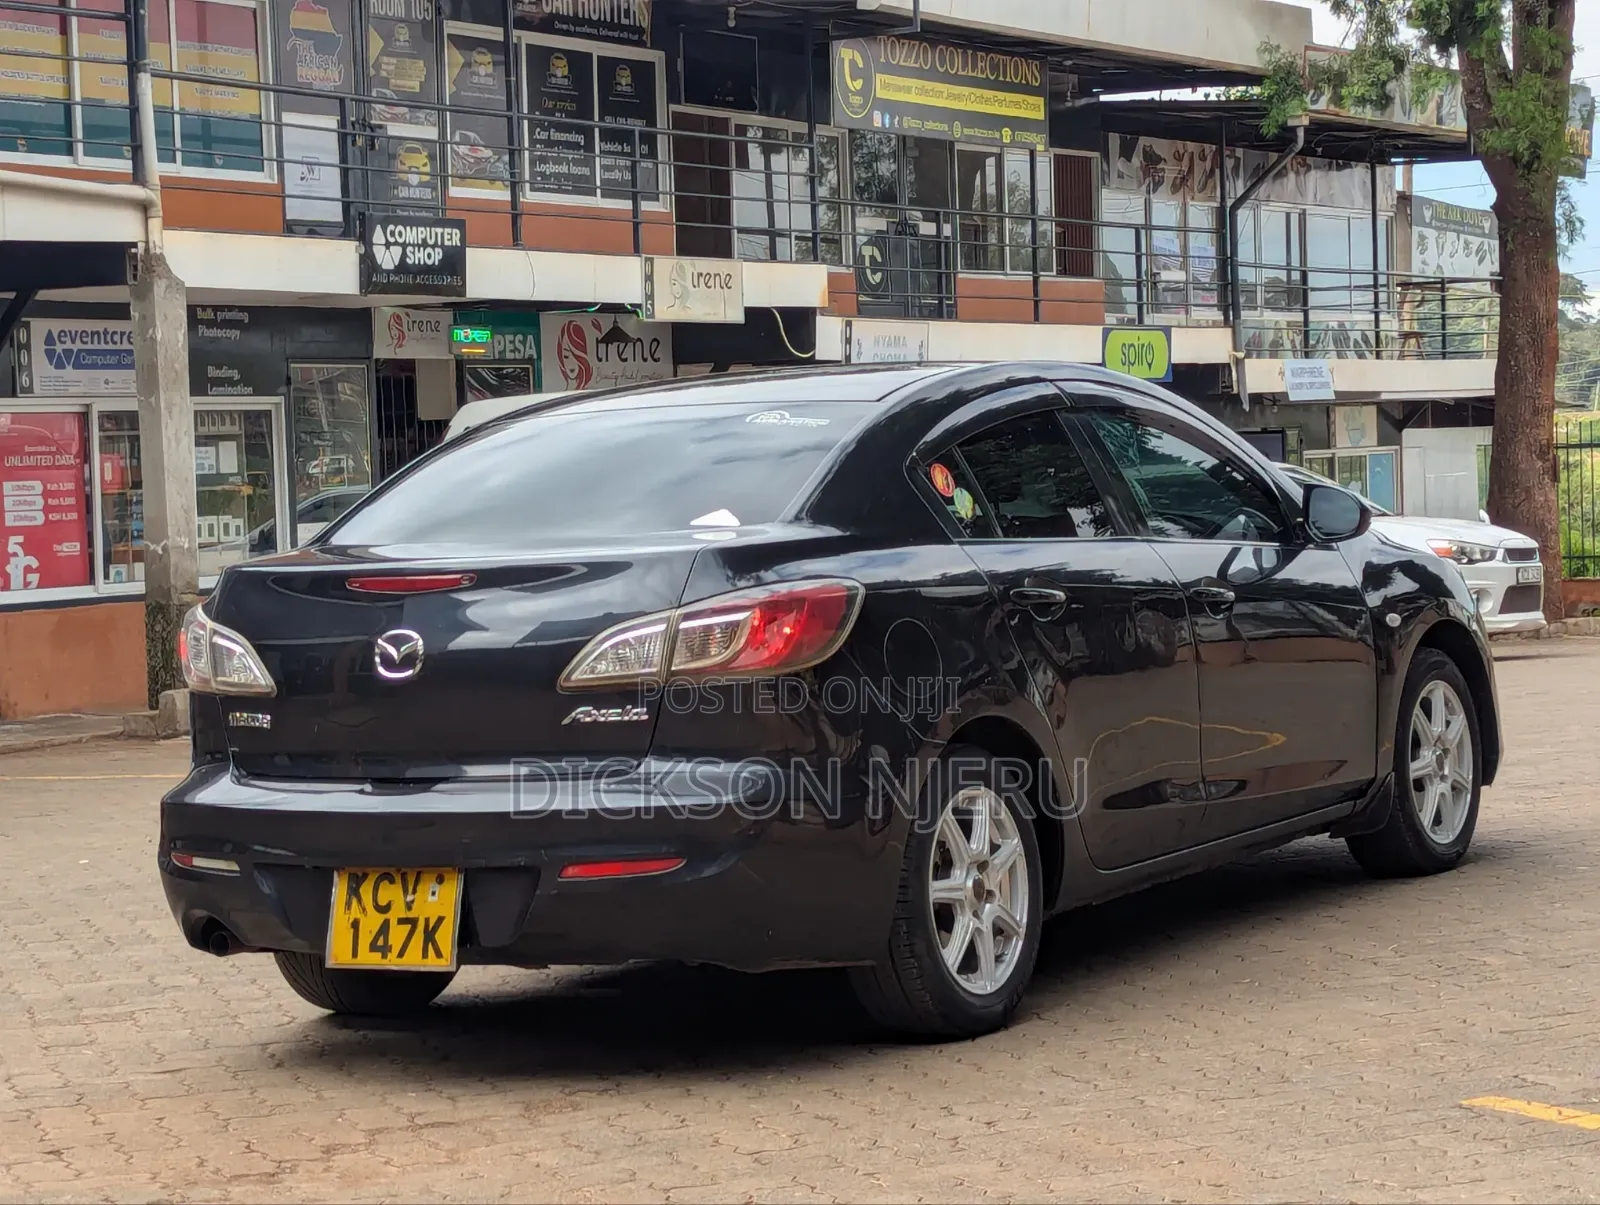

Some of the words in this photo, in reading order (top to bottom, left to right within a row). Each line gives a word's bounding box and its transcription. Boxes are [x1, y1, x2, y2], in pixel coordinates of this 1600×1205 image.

[877, 35, 932, 70] TOZZO
[935, 45, 1041, 87] COLLECTIONS
[386, 224, 461, 247] COMPUTER
[406, 246, 443, 265] SHOP
[196, 308, 216, 320] Bulk
[217, 310, 249, 324] printing
[406, 318, 441, 333] irene
[198, 325, 241, 340] Photocopy
[873, 335, 908, 349] NYAMA
[494, 334, 538, 359] PESA
[595, 336, 661, 362] irene
[1120, 336, 1155, 373] spiro
[80, 353, 119, 367] Computer
[208, 383, 254, 395] Lamination
[4, 455, 53, 467] UNLIMITED
[54, 454, 76, 467] DATA
[561, 705, 650, 725] Axela
[344, 870, 423, 917] KCV
[350, 915, 446, 960] 147K
